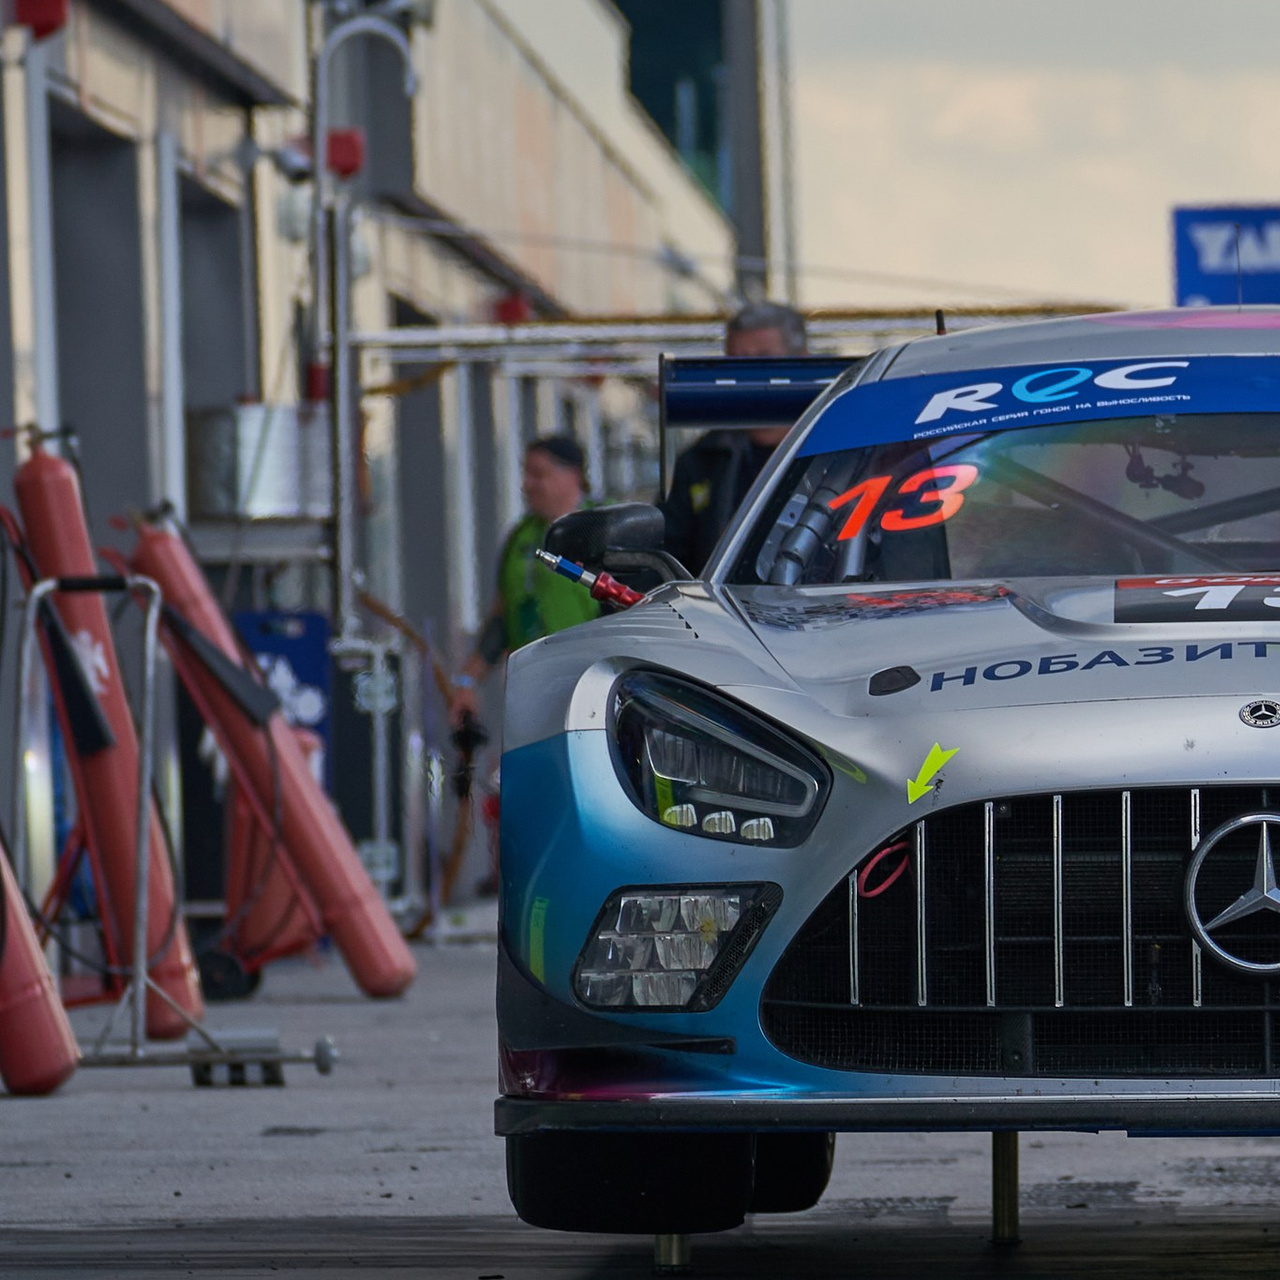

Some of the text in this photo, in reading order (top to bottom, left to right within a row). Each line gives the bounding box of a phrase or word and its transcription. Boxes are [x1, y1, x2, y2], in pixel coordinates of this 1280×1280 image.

[991, 410, 1030, 423] СЕРИЯ
[1032, 404, 1071, 416] ГОНОК
[1075, 401, 1093, 410] НА
[1096, 394, 1192, 408] ВЫНОСЛИВОСТЬ
[827, 464, 979, 542] 13
